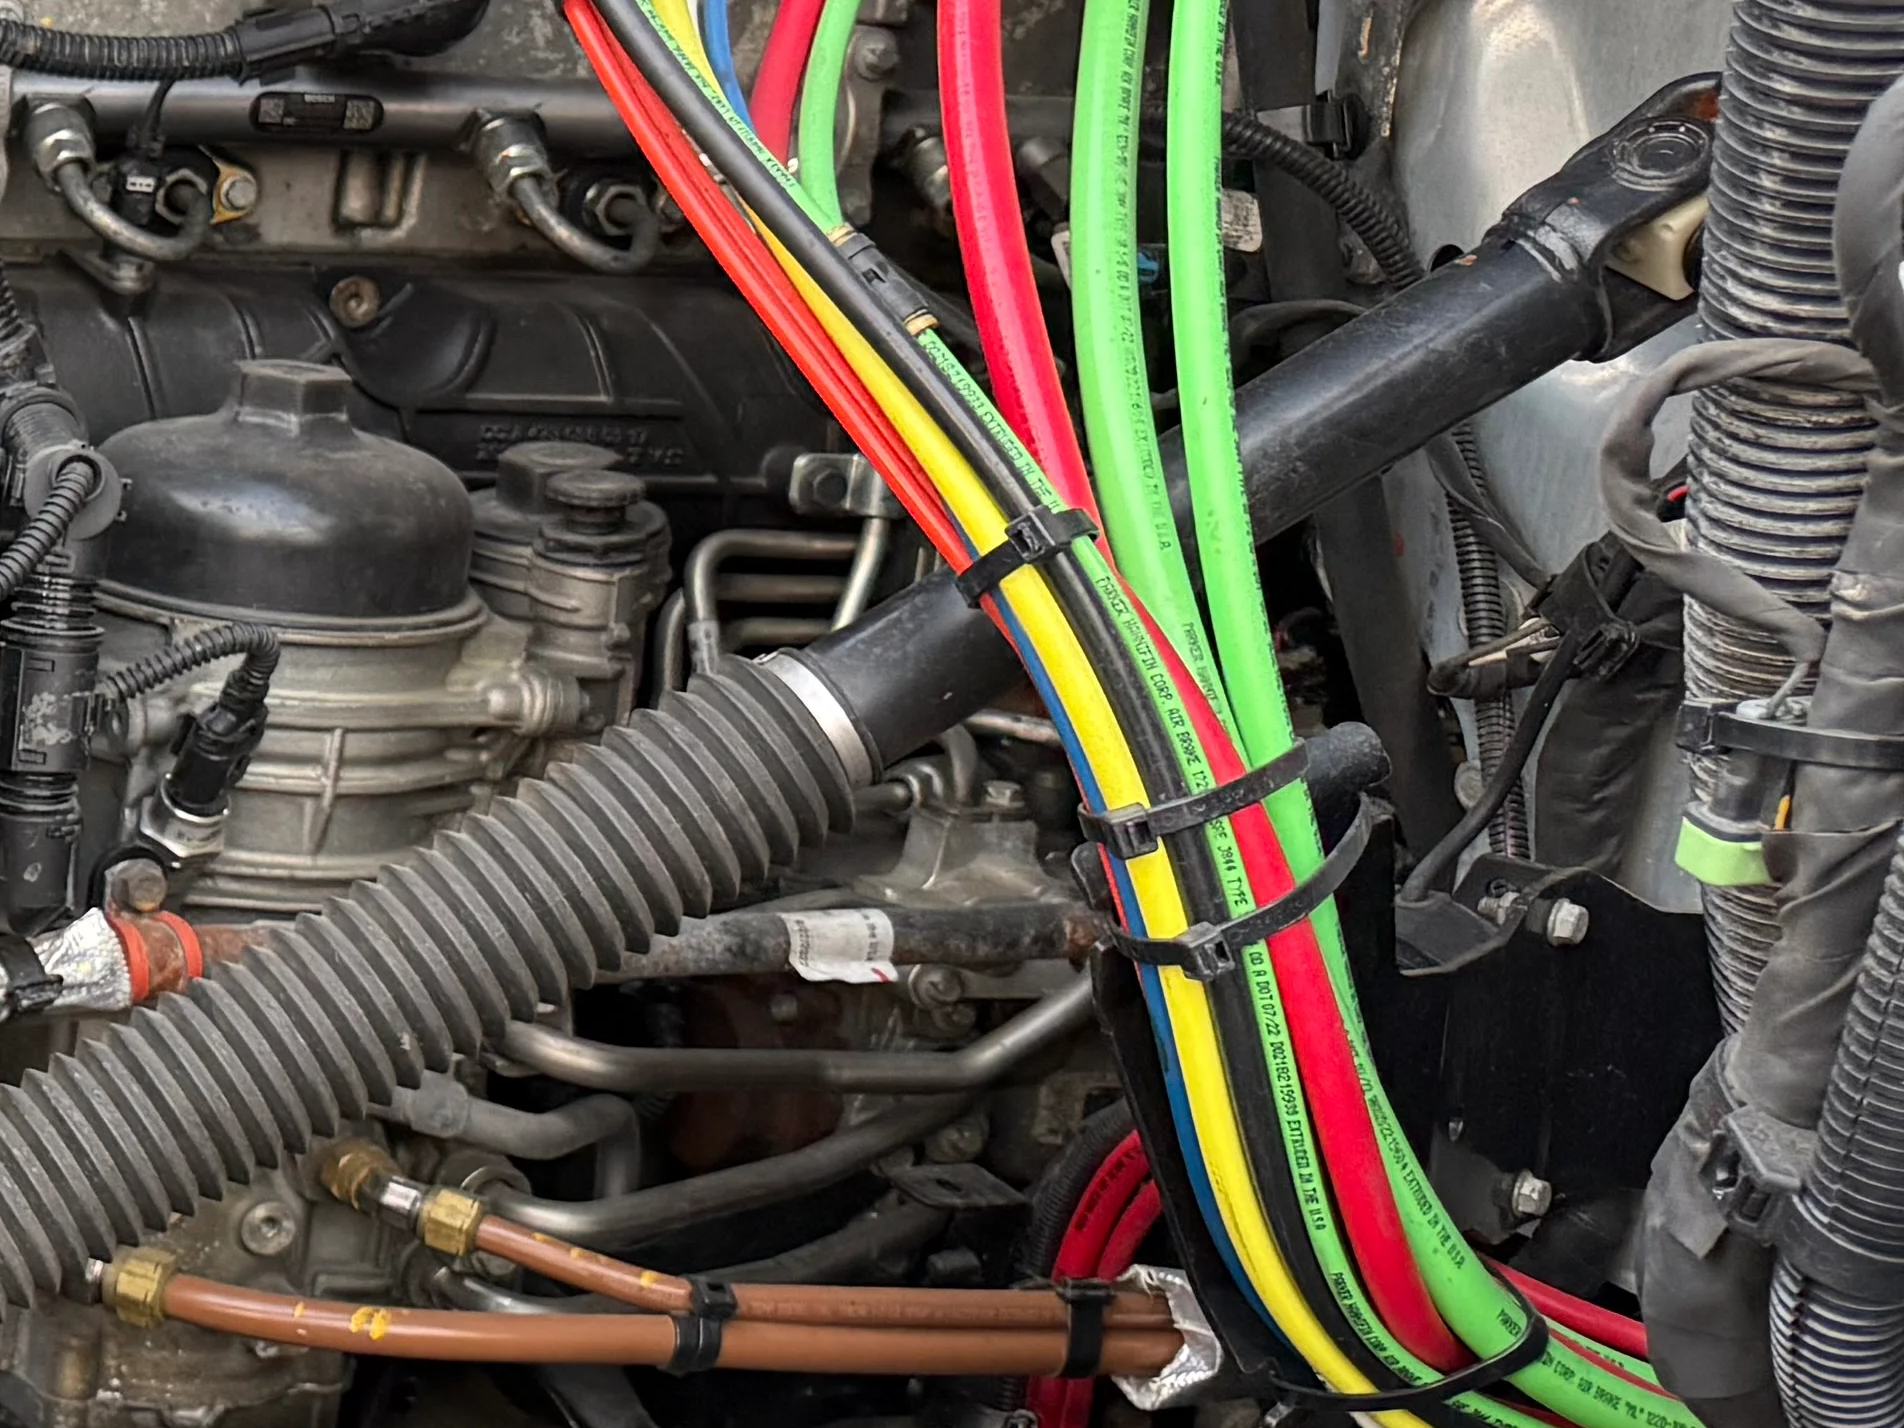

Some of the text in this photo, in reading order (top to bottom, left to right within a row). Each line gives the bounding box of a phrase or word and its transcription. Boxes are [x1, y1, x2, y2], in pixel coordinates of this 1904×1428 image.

[1095, 576, 1130, 618] PARKER
[1167, 707, 1185, 731] AIR
[1227, 875, 1249, 908] TYPE
[1256, 979, 1274, 1002] DOT
